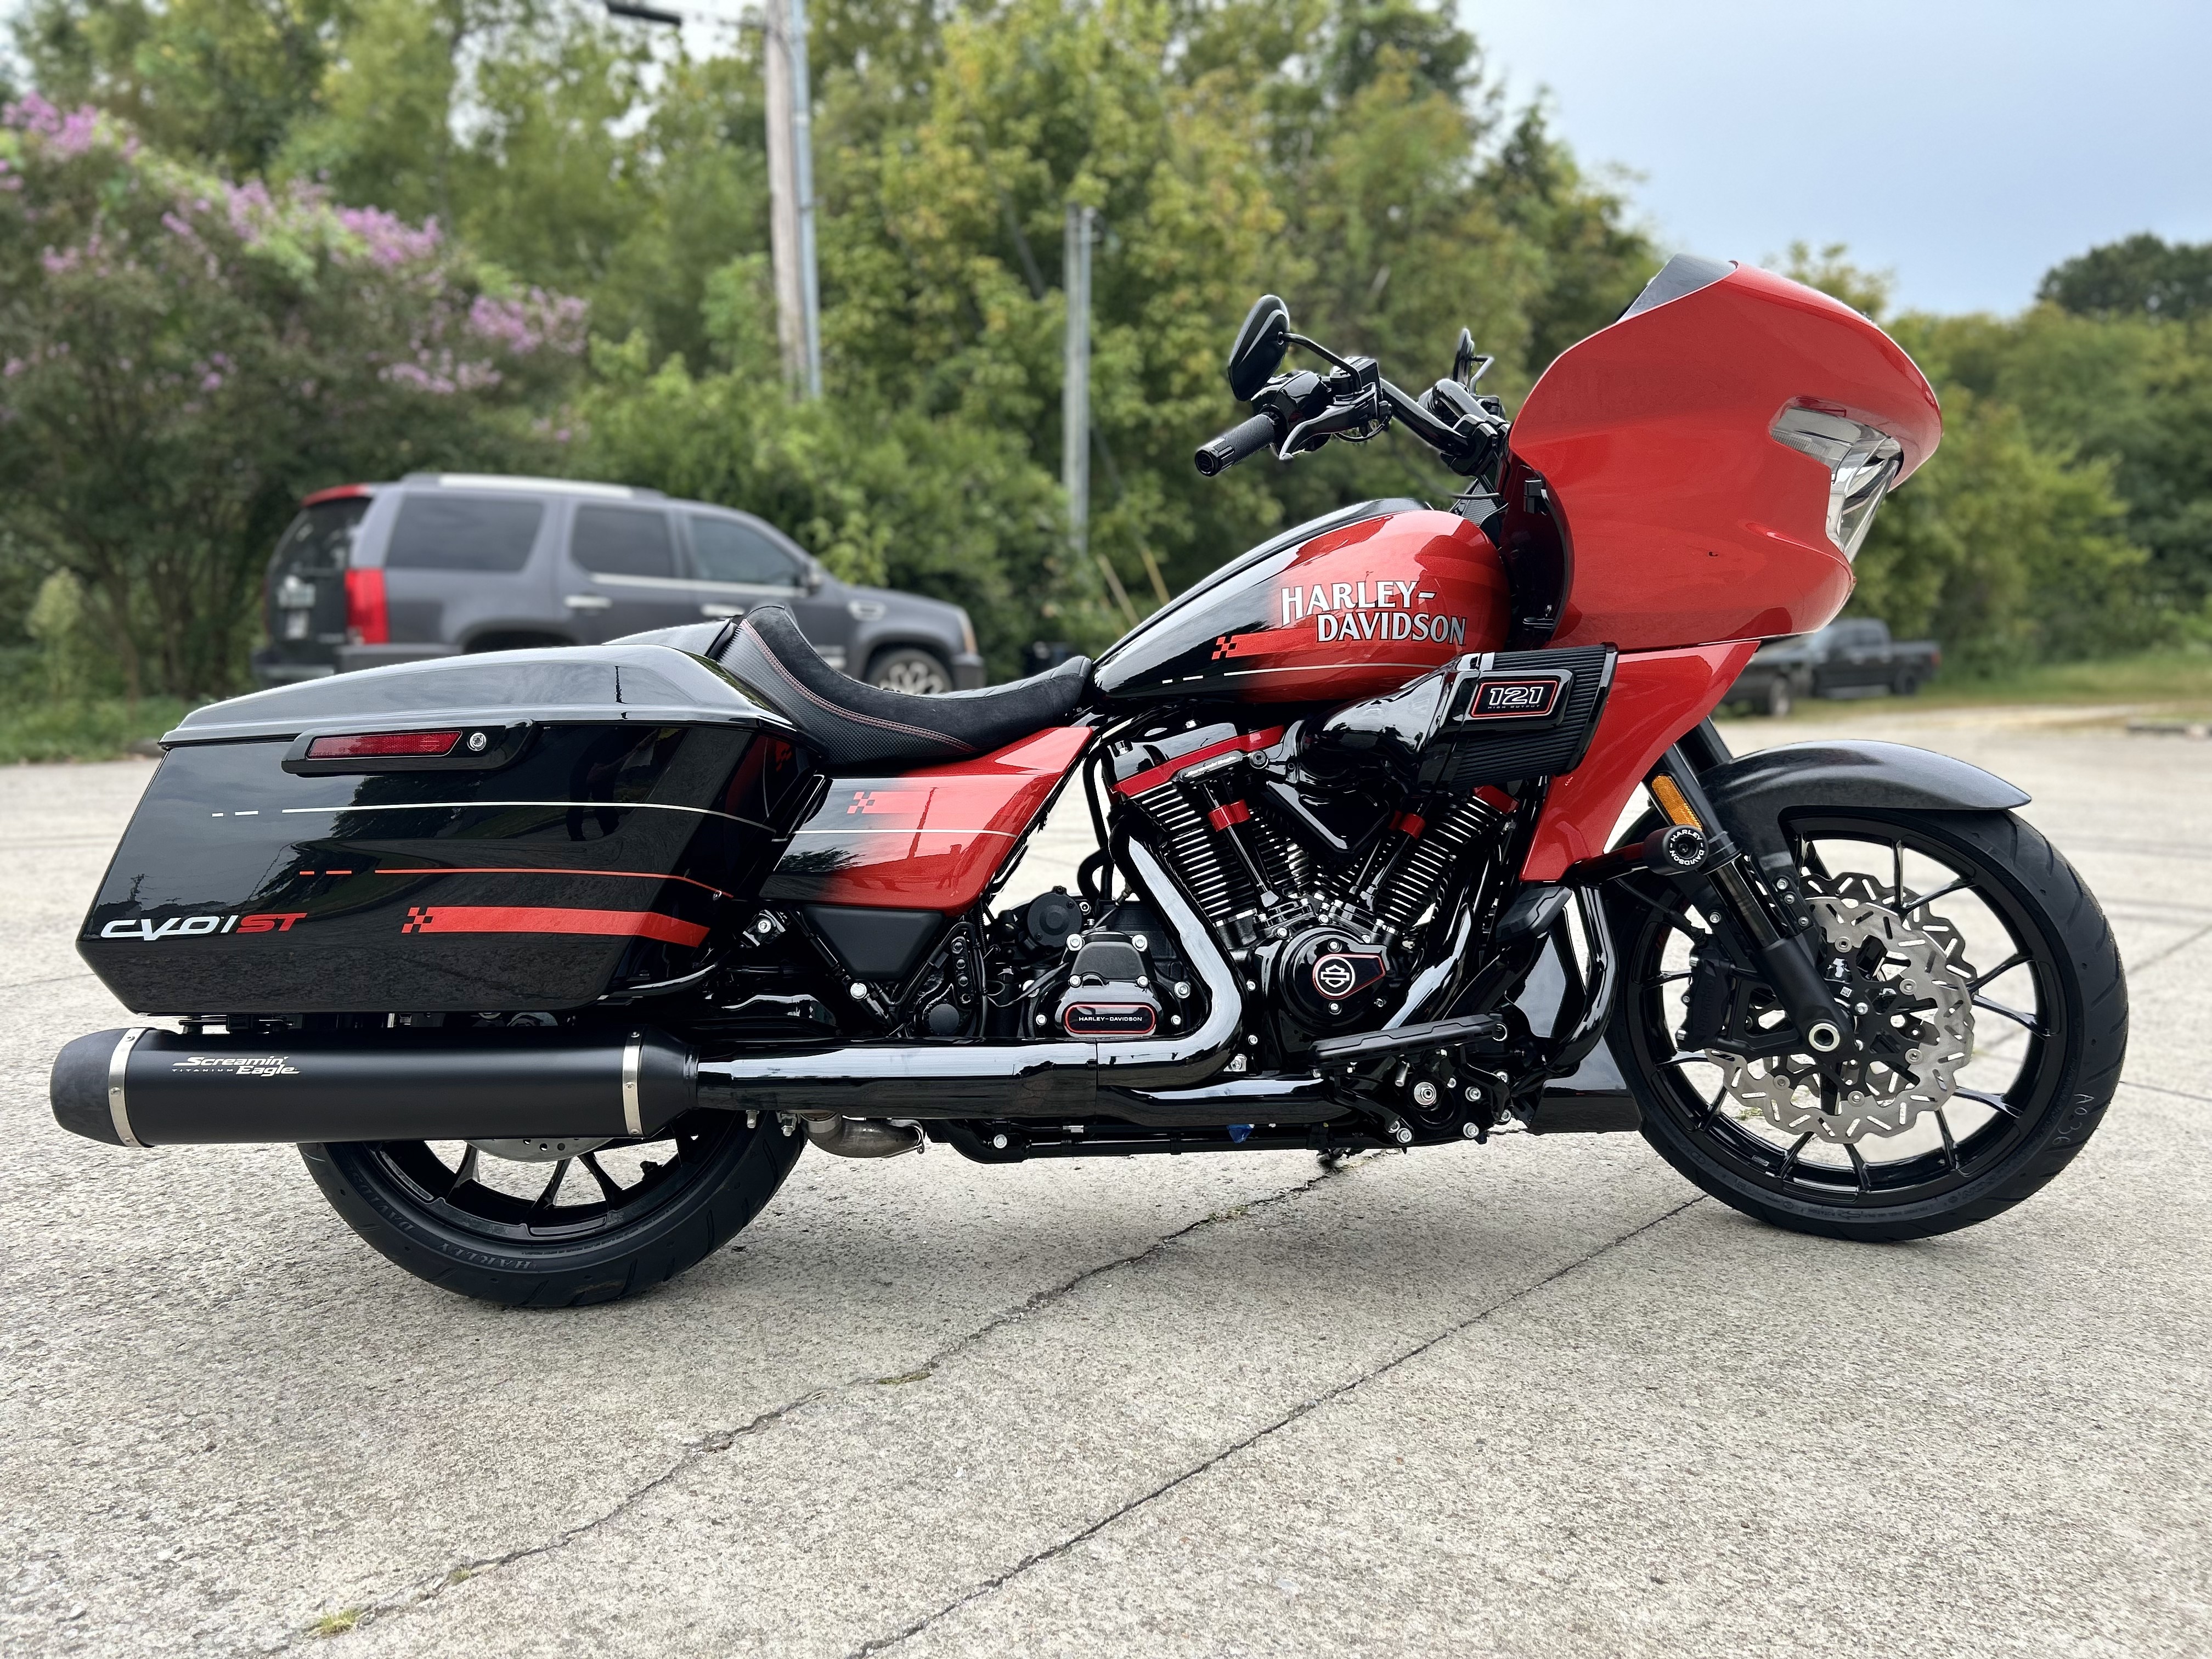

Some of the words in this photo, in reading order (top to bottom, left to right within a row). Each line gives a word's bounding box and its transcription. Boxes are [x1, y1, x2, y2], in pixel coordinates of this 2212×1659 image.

[1317, 612, 1467, 646] DAVIDSON
[1488, 686, 1544, 706] 121
[1671, 829, 1703, 842] HARLEY
[1669, 849, 1705, 866] DAVIDSON
[172, 1056, 289, 1066] Screamin'
[236, 1064, 301, 1077] Eagle
